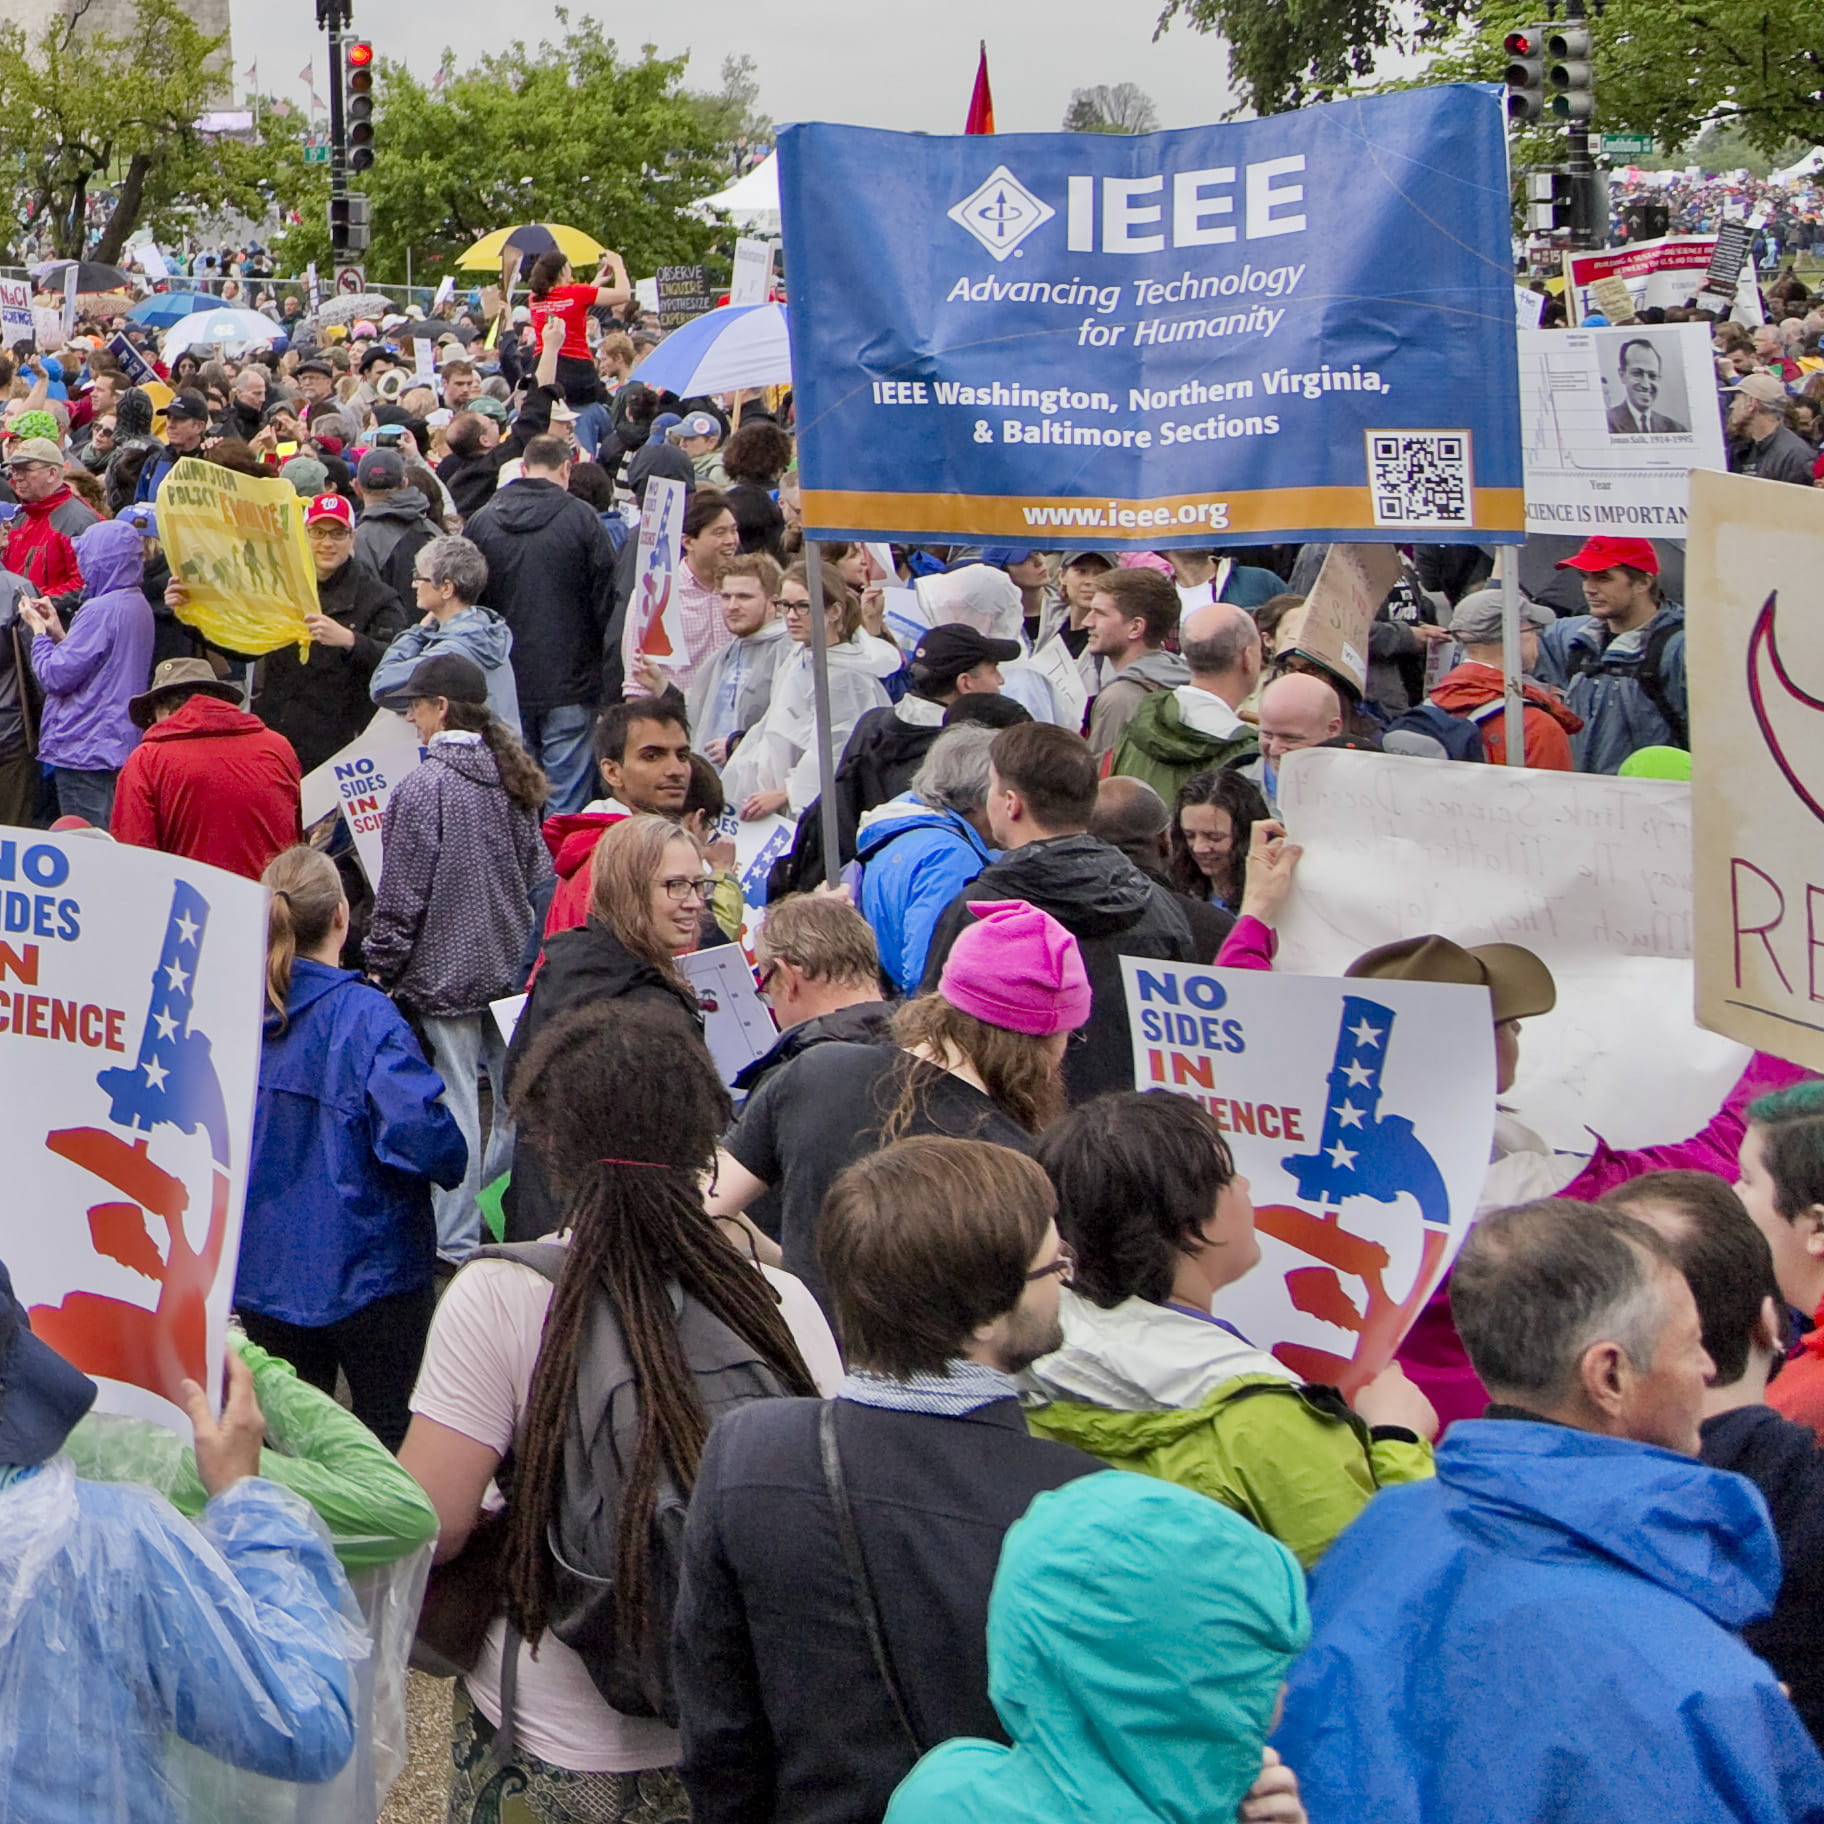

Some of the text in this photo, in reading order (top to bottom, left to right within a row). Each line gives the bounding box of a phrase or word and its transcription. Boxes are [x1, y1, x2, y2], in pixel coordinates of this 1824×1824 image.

[1066, 153, 1308, 254] IEEE
[657, 264, 703, 282] OBSERVE
[946, 262, 1307, 314] Advancing Technology
[2, 311, 35, 327] SCIENCE
[1077, 305, 1286, 347] for Humanity
[872, 364, 1393, 415] IEEE Washington, Northern Virginia,
[973, 414, 1281, 449] & Baltimore Sections
[178, 462, 210, 486] RUMP
[1591, 478, 1612, 492] Year
[1023, 501, 1230, 530] www.ieee.org
[1578, 504, 1593, 522] IS
[1594, 506, 1690, 526] IMPORTAN
[333, 756, 375, 781] NO
[339, 773, 388, 799] SIDES
[346, 795, 380, 817] IN
[353, 812, 387, 835] SCIE
[716, 817, 739, 838] DES
[1135, 969, 1228, 1011] NO
[1142, 1008, 1246, 1054] SIDES
[1148, 1049, 1215, 1090] IN
[1199, 1098, 1305, 1142] ENCE
